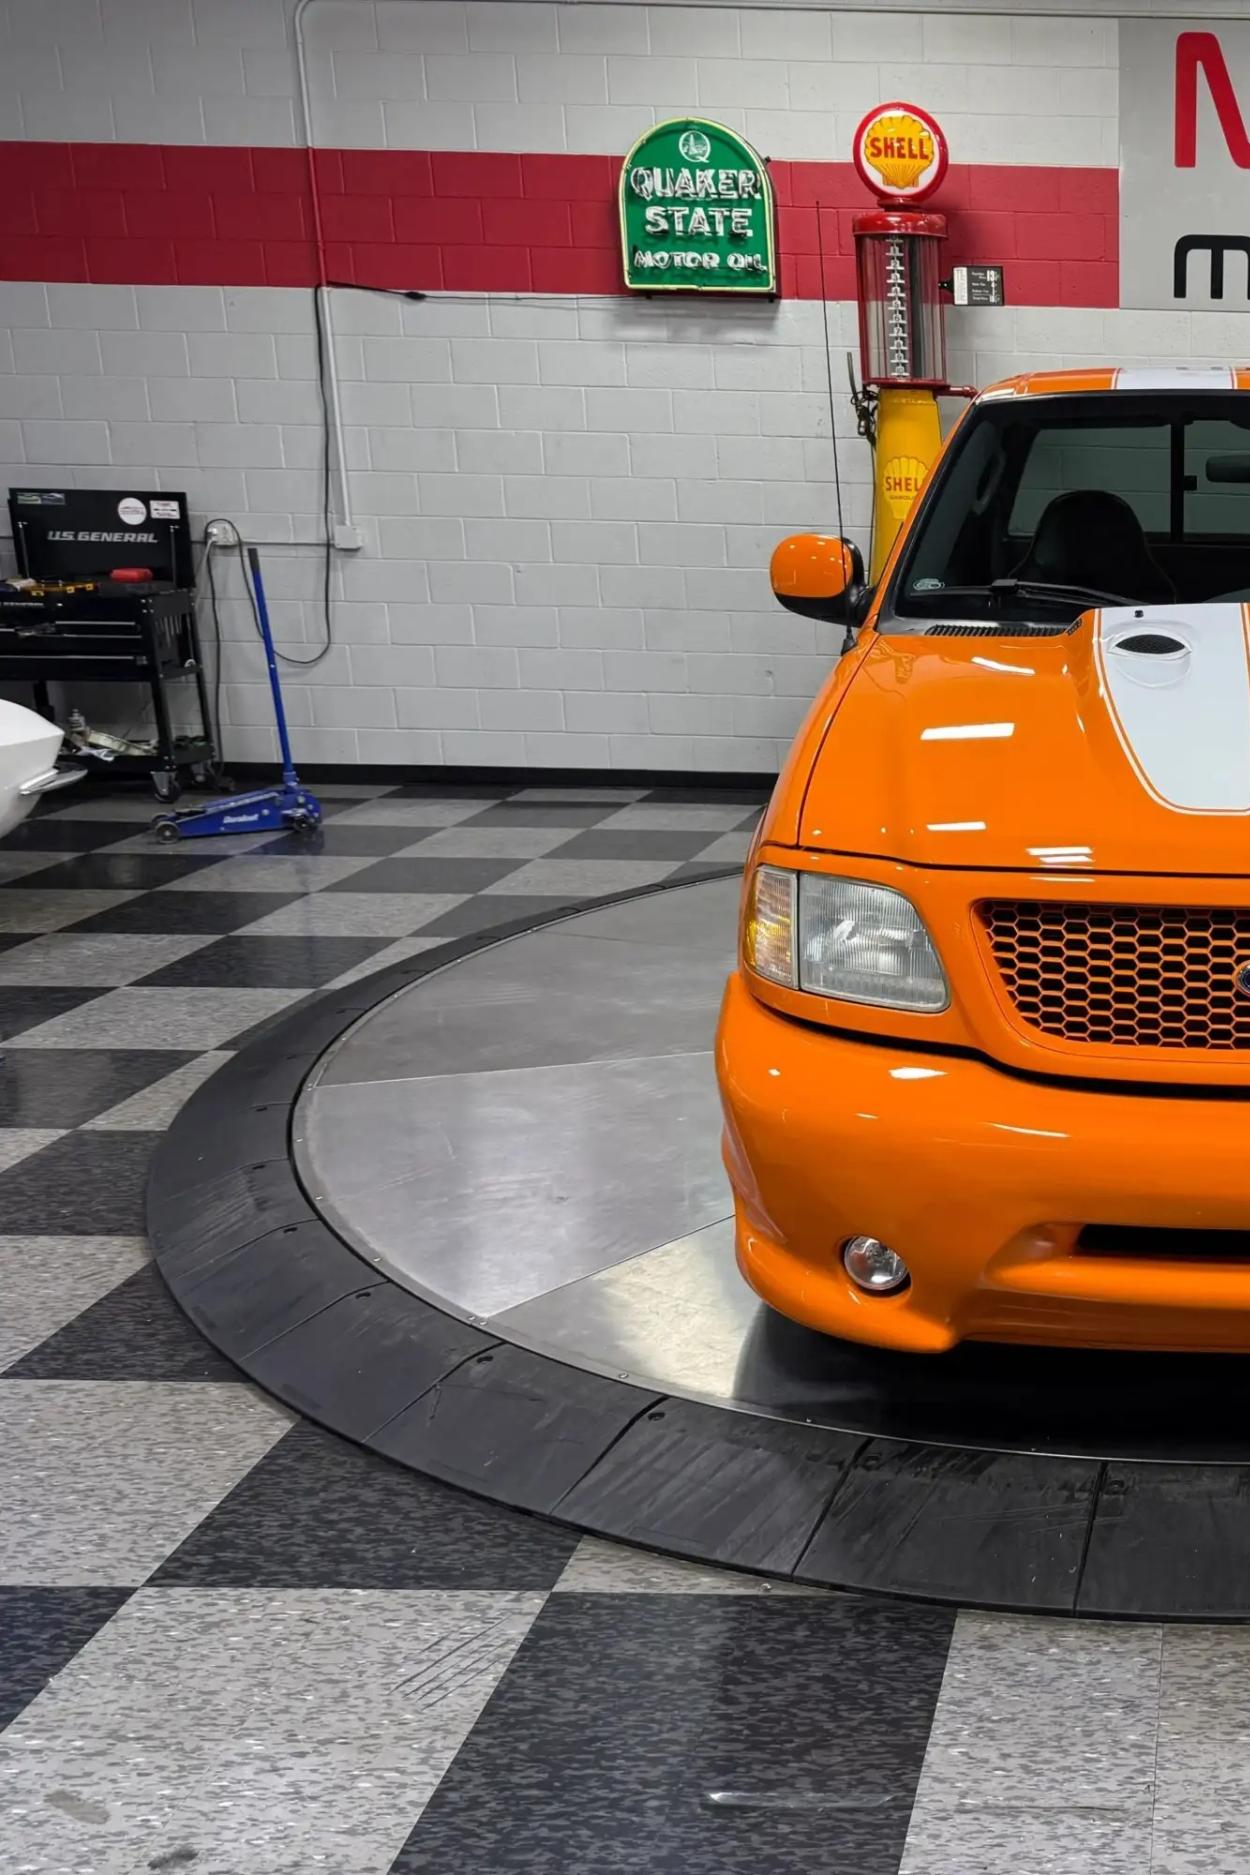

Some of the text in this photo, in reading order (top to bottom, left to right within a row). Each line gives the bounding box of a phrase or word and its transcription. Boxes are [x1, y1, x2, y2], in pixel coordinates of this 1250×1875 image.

[869, 136, 930, 161] SHELL
[630, 166, 763, 201] QUAKER
[645, 205, 754, 238] STATE
[633, 249, 768, 272] MOTOR OIL
[884, 476, 920, 492] SHEL
[77, 531, 159, 543] GENERAL
